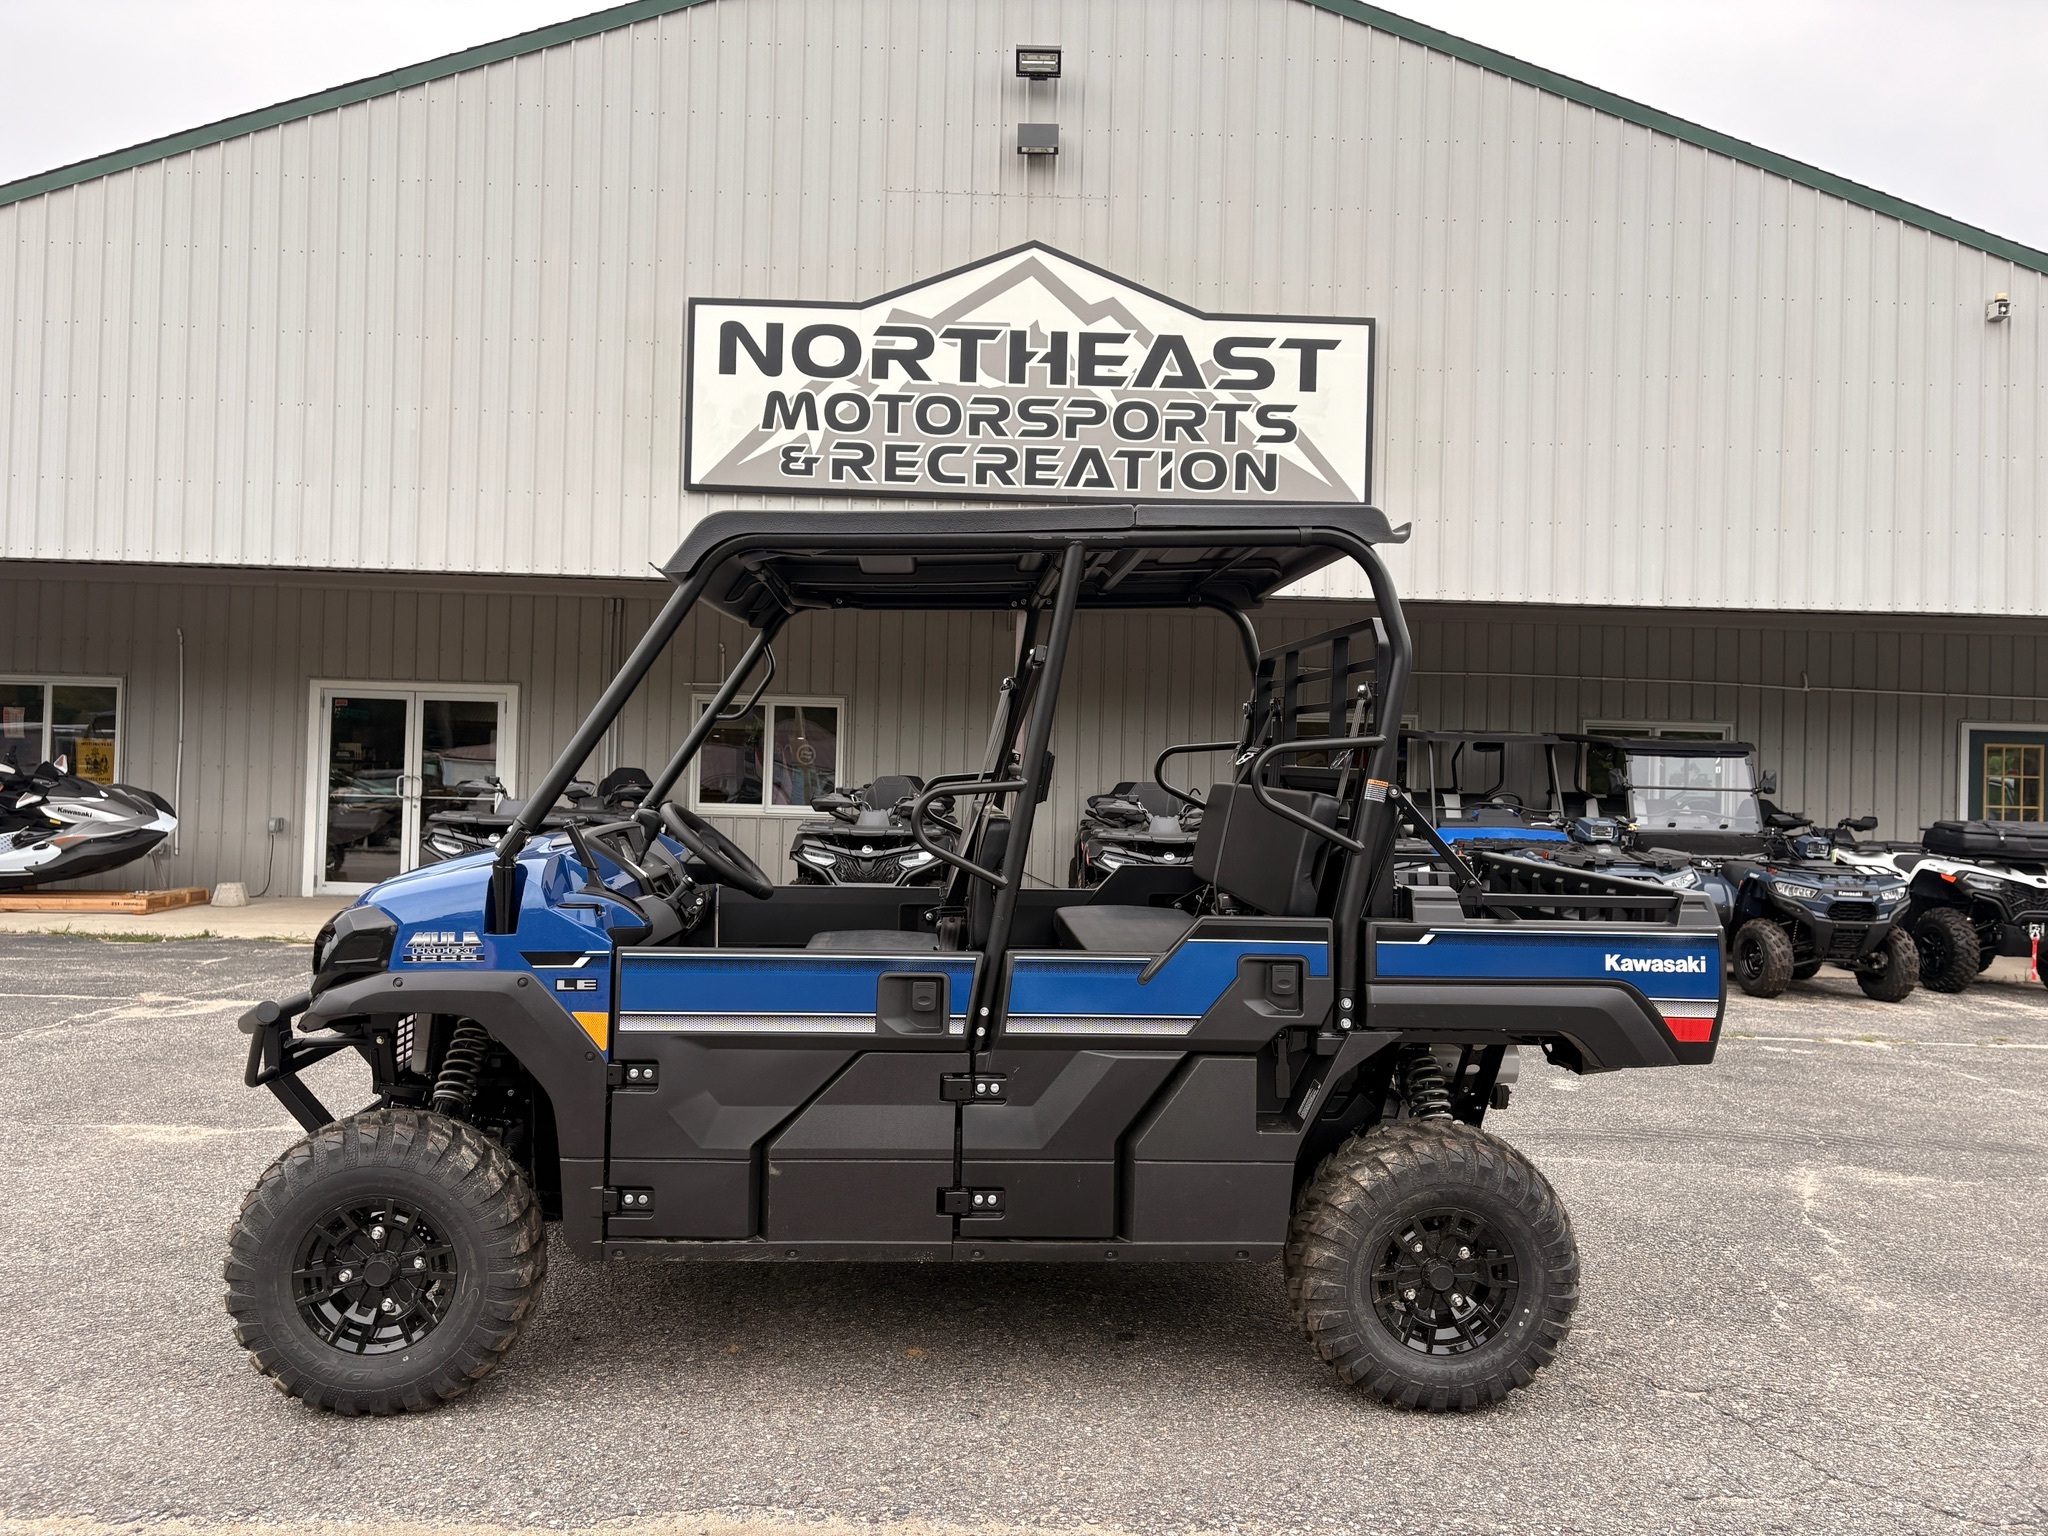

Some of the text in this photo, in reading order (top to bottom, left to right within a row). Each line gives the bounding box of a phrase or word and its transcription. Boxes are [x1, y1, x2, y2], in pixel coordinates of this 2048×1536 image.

[719, 321, 1341, 393] NORTHEAST
[761, 390, 1299, 444] MOTORSPORTS
[57, 806, 93, 818] Kawasaki
[405, 931, 484, 948] MULE
[1604, 953, 1707, 973] Kawasaki
[556, 979, 597, 990] LE
